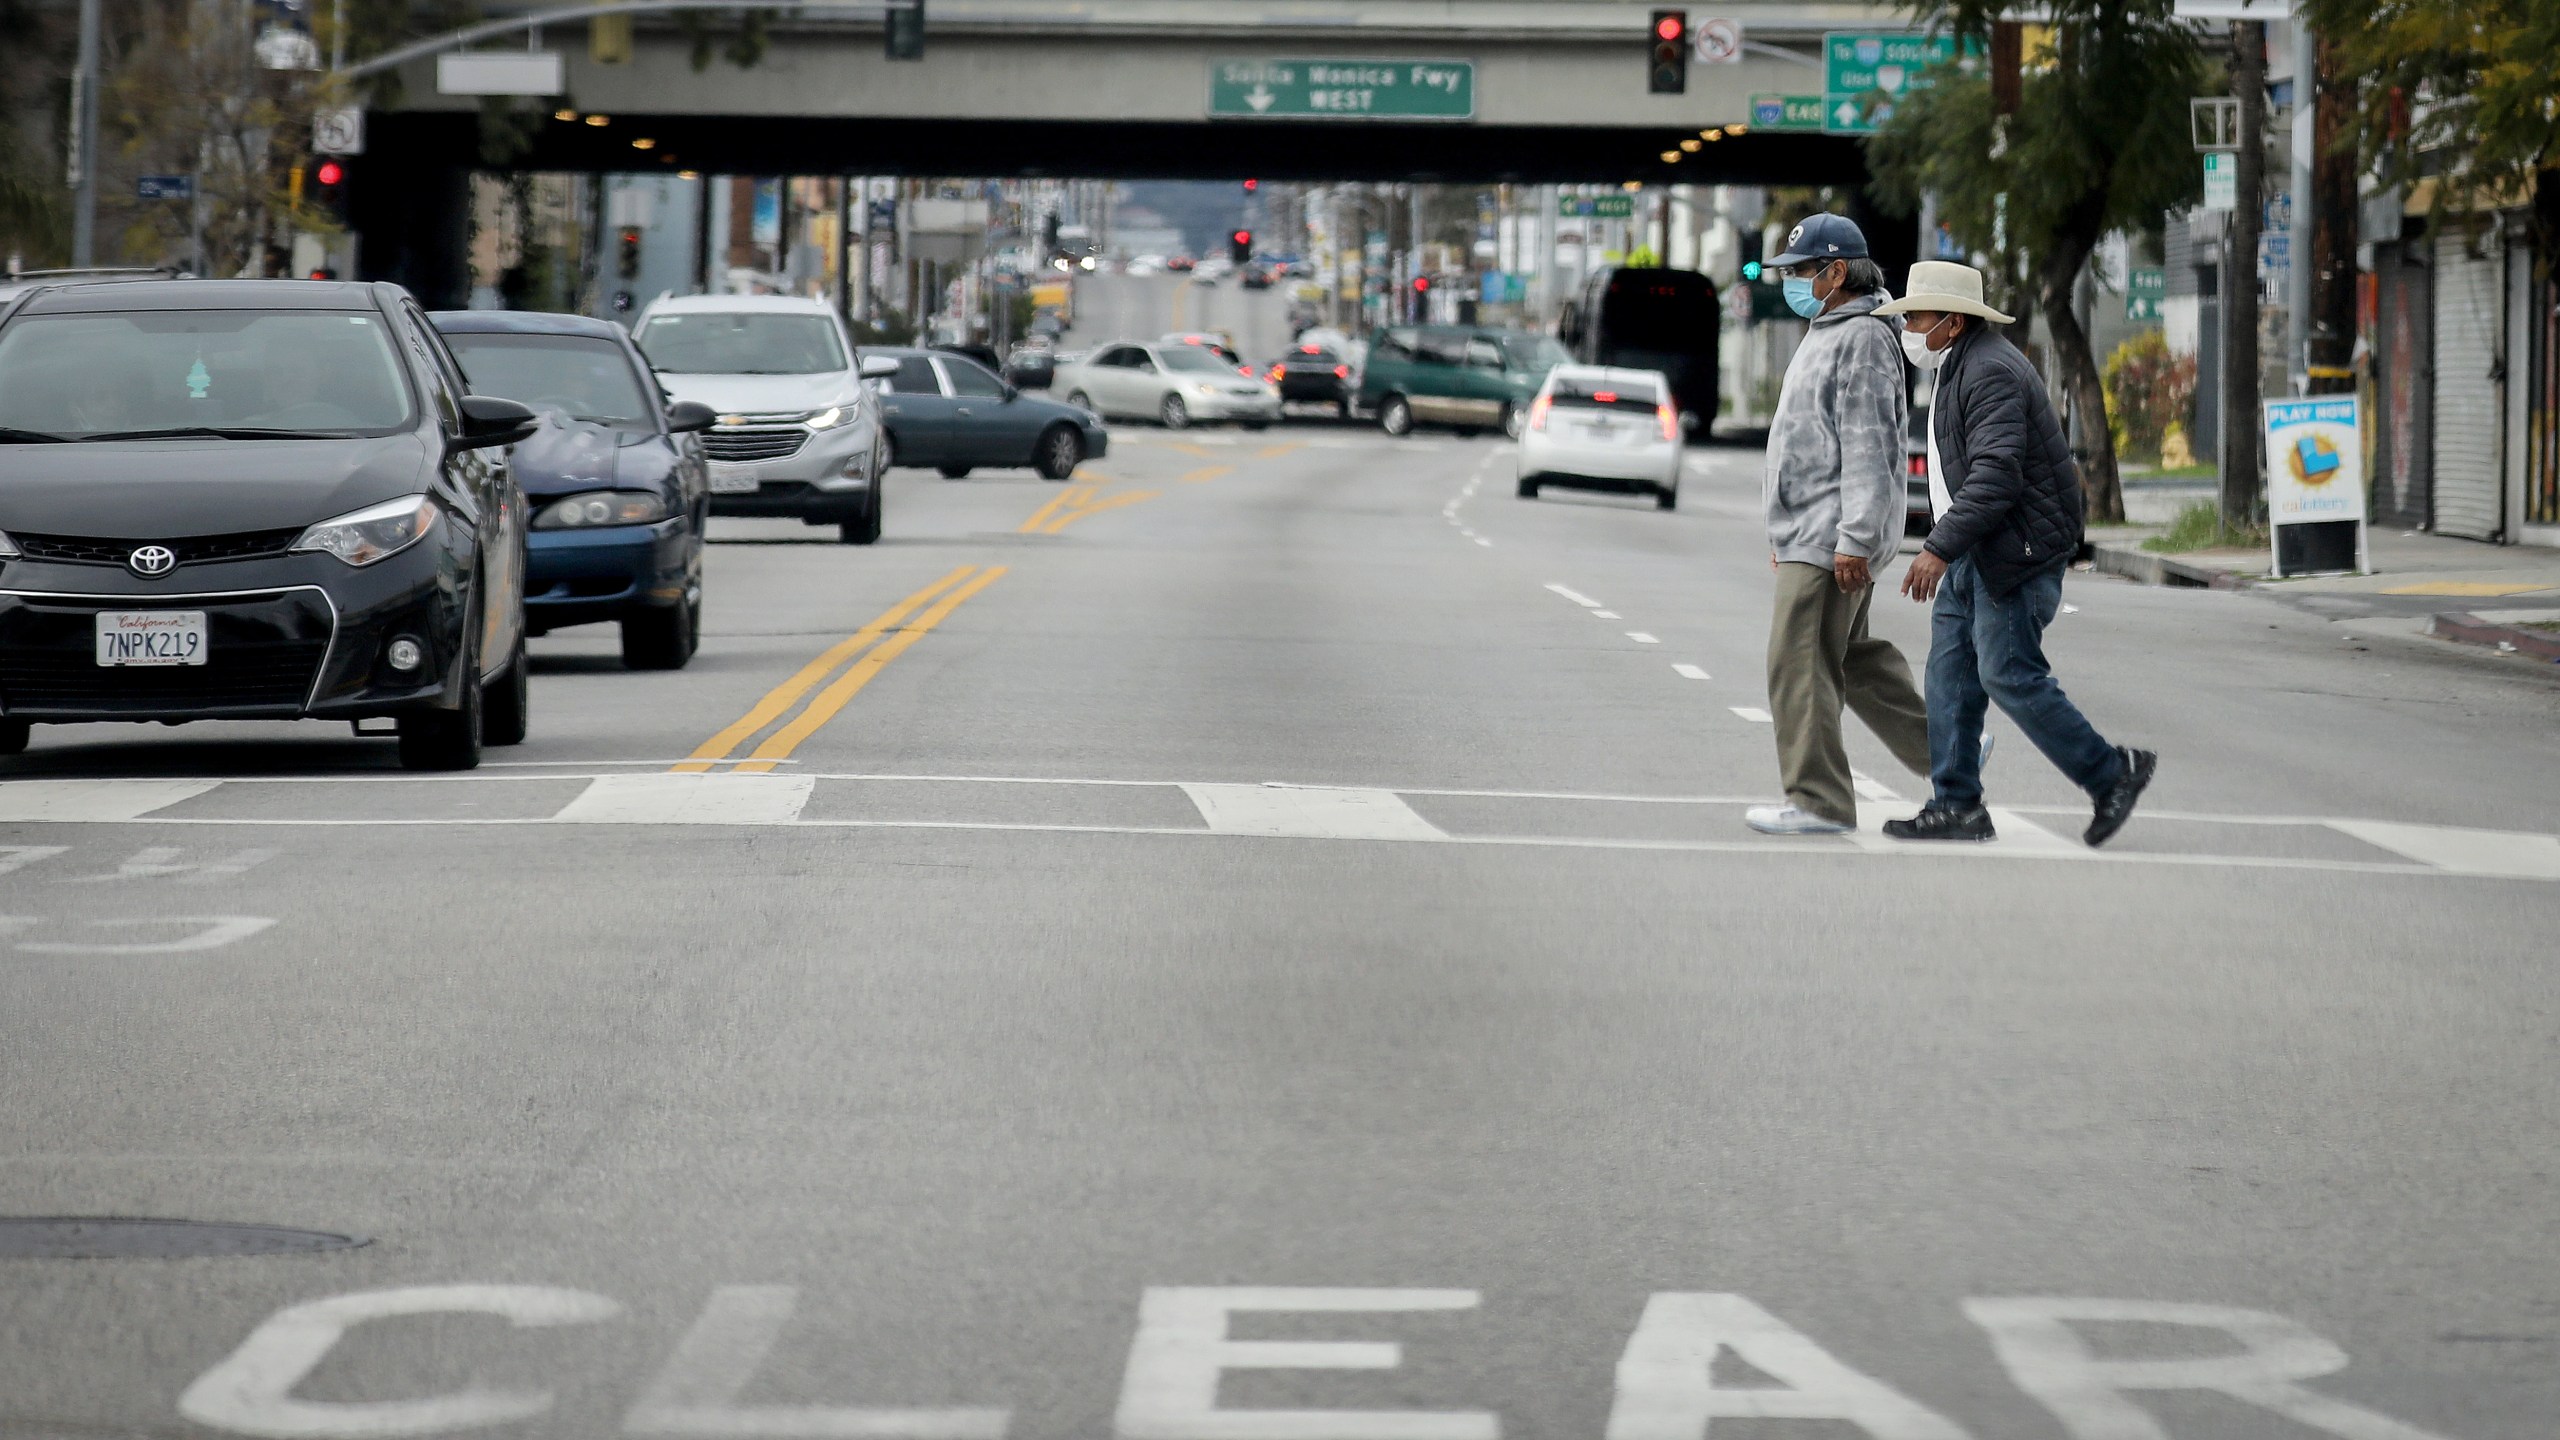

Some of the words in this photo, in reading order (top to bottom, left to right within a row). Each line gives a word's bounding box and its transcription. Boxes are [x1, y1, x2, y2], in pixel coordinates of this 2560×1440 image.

[1223, 64, 1295, 85] Santa
[1308, 66, 1396, 86] Monica
[1411, 66, 1462, 95] Fwy
[1309, 90, 1374, 111] WEST
[1785, 102, 1822, 121] EAS
[2269, 405, 2313, 424] PLAY
[2315, 403, 2353, 419] NOW
[119, 615, 184, 631] California
[103, 632, 198, 657] 7NPK219
[176, 1284, 2447, 1440] CLEAR
